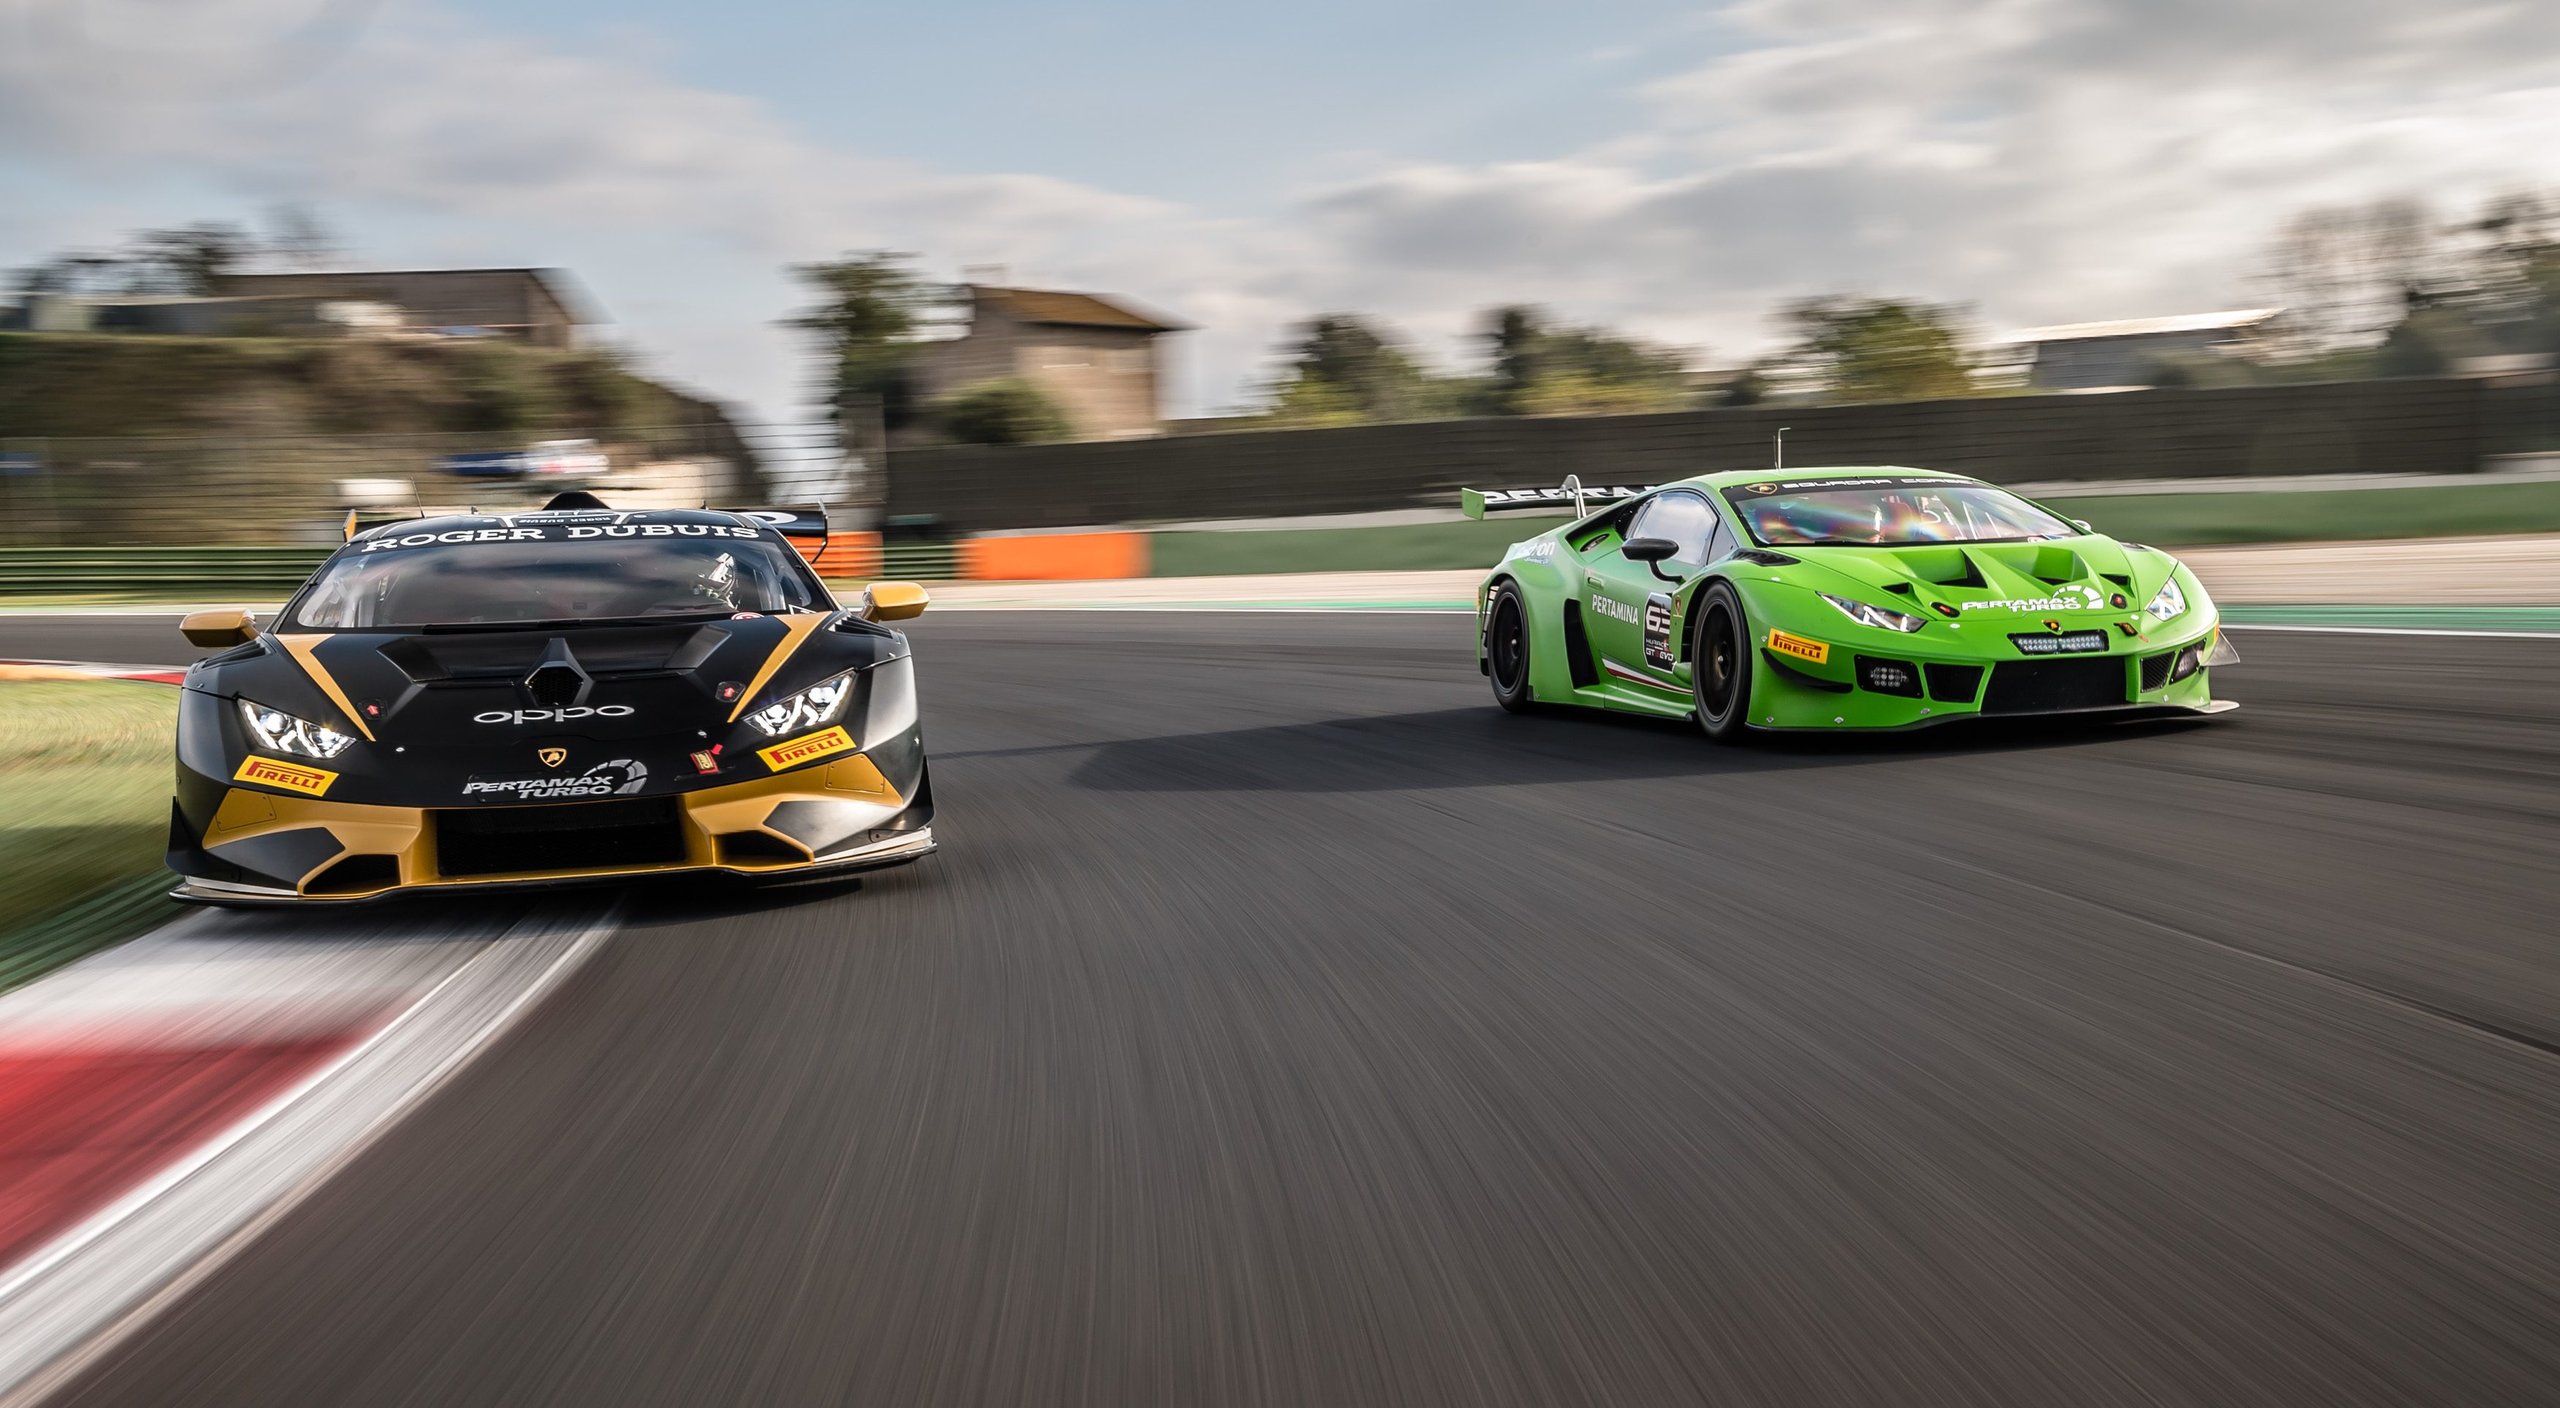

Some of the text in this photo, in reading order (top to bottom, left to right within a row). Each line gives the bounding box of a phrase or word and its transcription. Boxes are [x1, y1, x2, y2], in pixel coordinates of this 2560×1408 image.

[1781, 478, 1892, 489] SQUADRA
[361, 524, 759, 553] ROGER DUBUIS
[1592, 594, 1639, 625] PERTAMINA
[1961, 597, 2077, 610] PERTAMAX
[2008, 602, 2082, 612] TURBO
[1773, 633, 1822, 659] PIRELLI
[769, 732, 844, 764] PIRELLI
[246, 761, 325, 789] PIRELLI
[462, 776, 613, 794] PERTAMAX
[519, 785, 612, 799] TURBO
